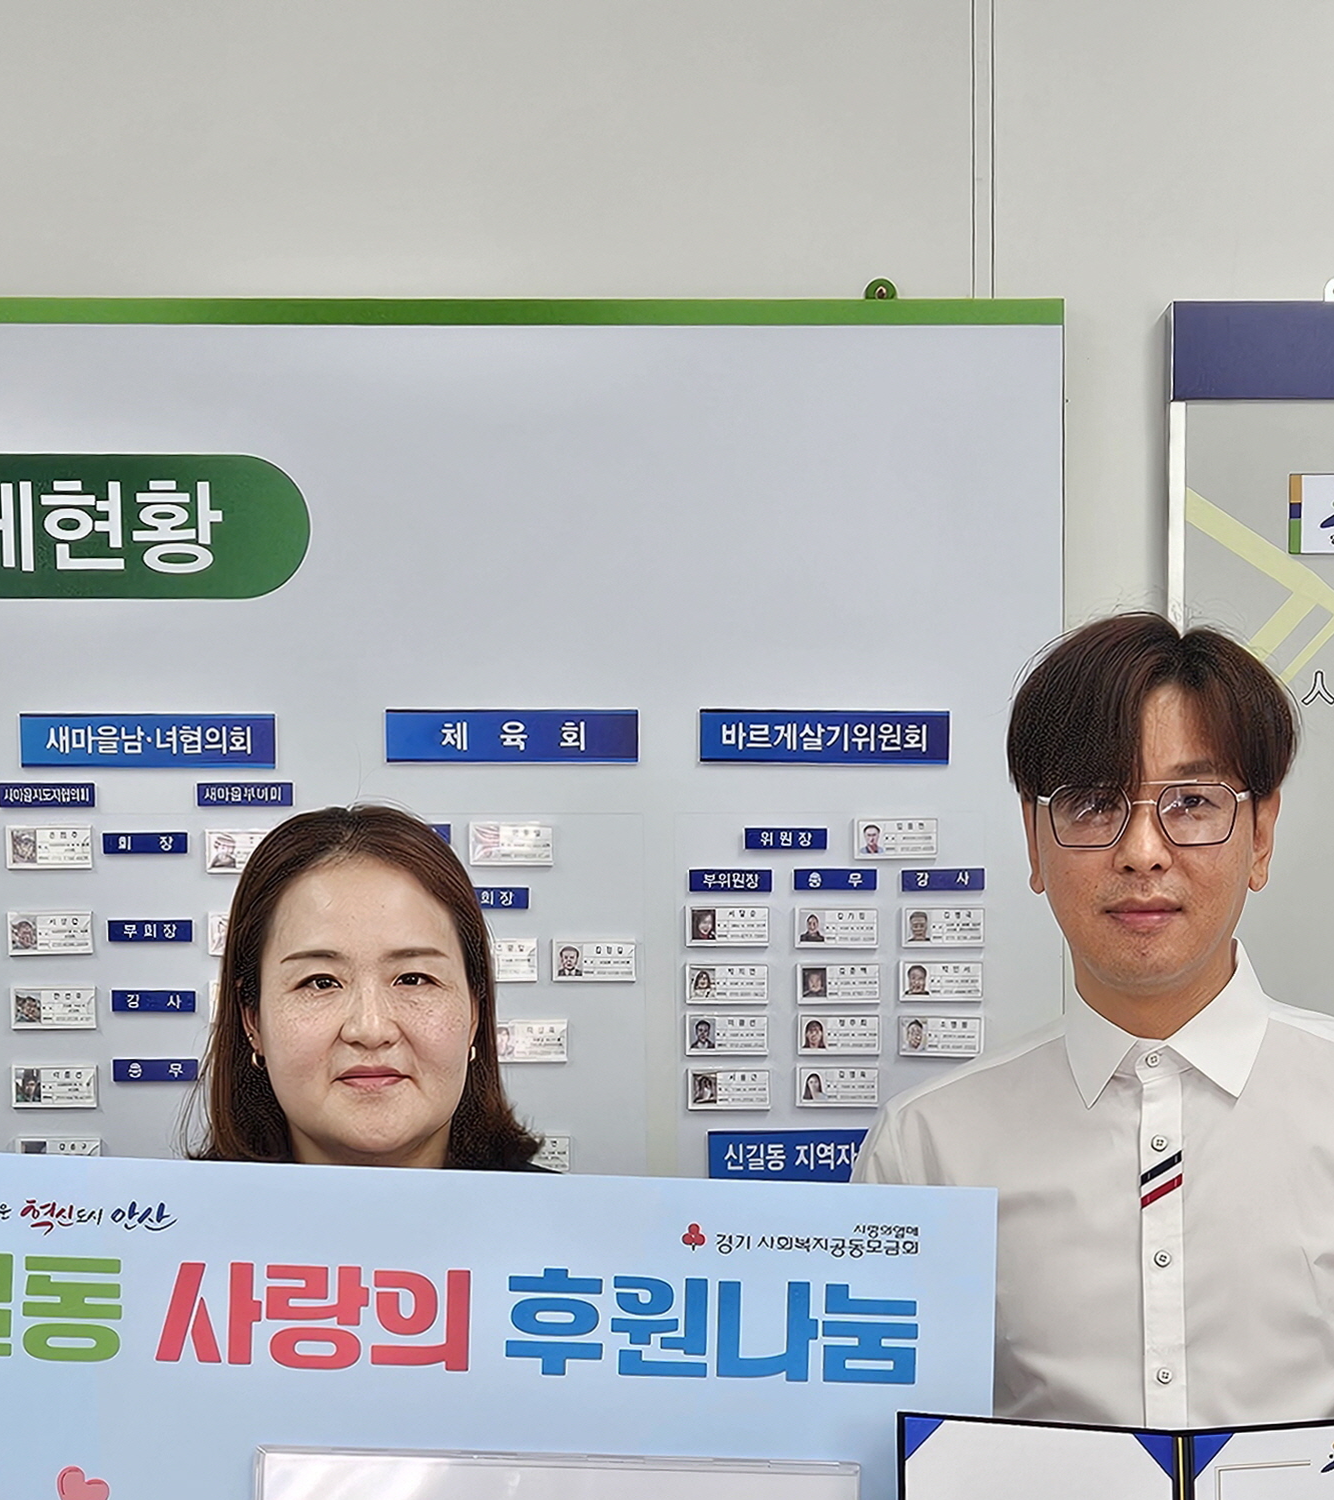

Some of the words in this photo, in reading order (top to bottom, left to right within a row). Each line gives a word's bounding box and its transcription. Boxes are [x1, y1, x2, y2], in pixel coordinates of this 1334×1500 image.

[721, 722, 927, 754] 바르게살기위원회
[723, 1142, 786, 1171] 신길동
[20, 1199, 104, 1235] 혁신도시
[110, 1201, 177, 1232] 안산
[716, 1234, 751, 1254] 경기
[757, 1237, 919, 1258] 사회복지공동모금회
[154, 1260, 472, 1373] 사랑의
[504, 1268, 922, 1385] 후원나눔
